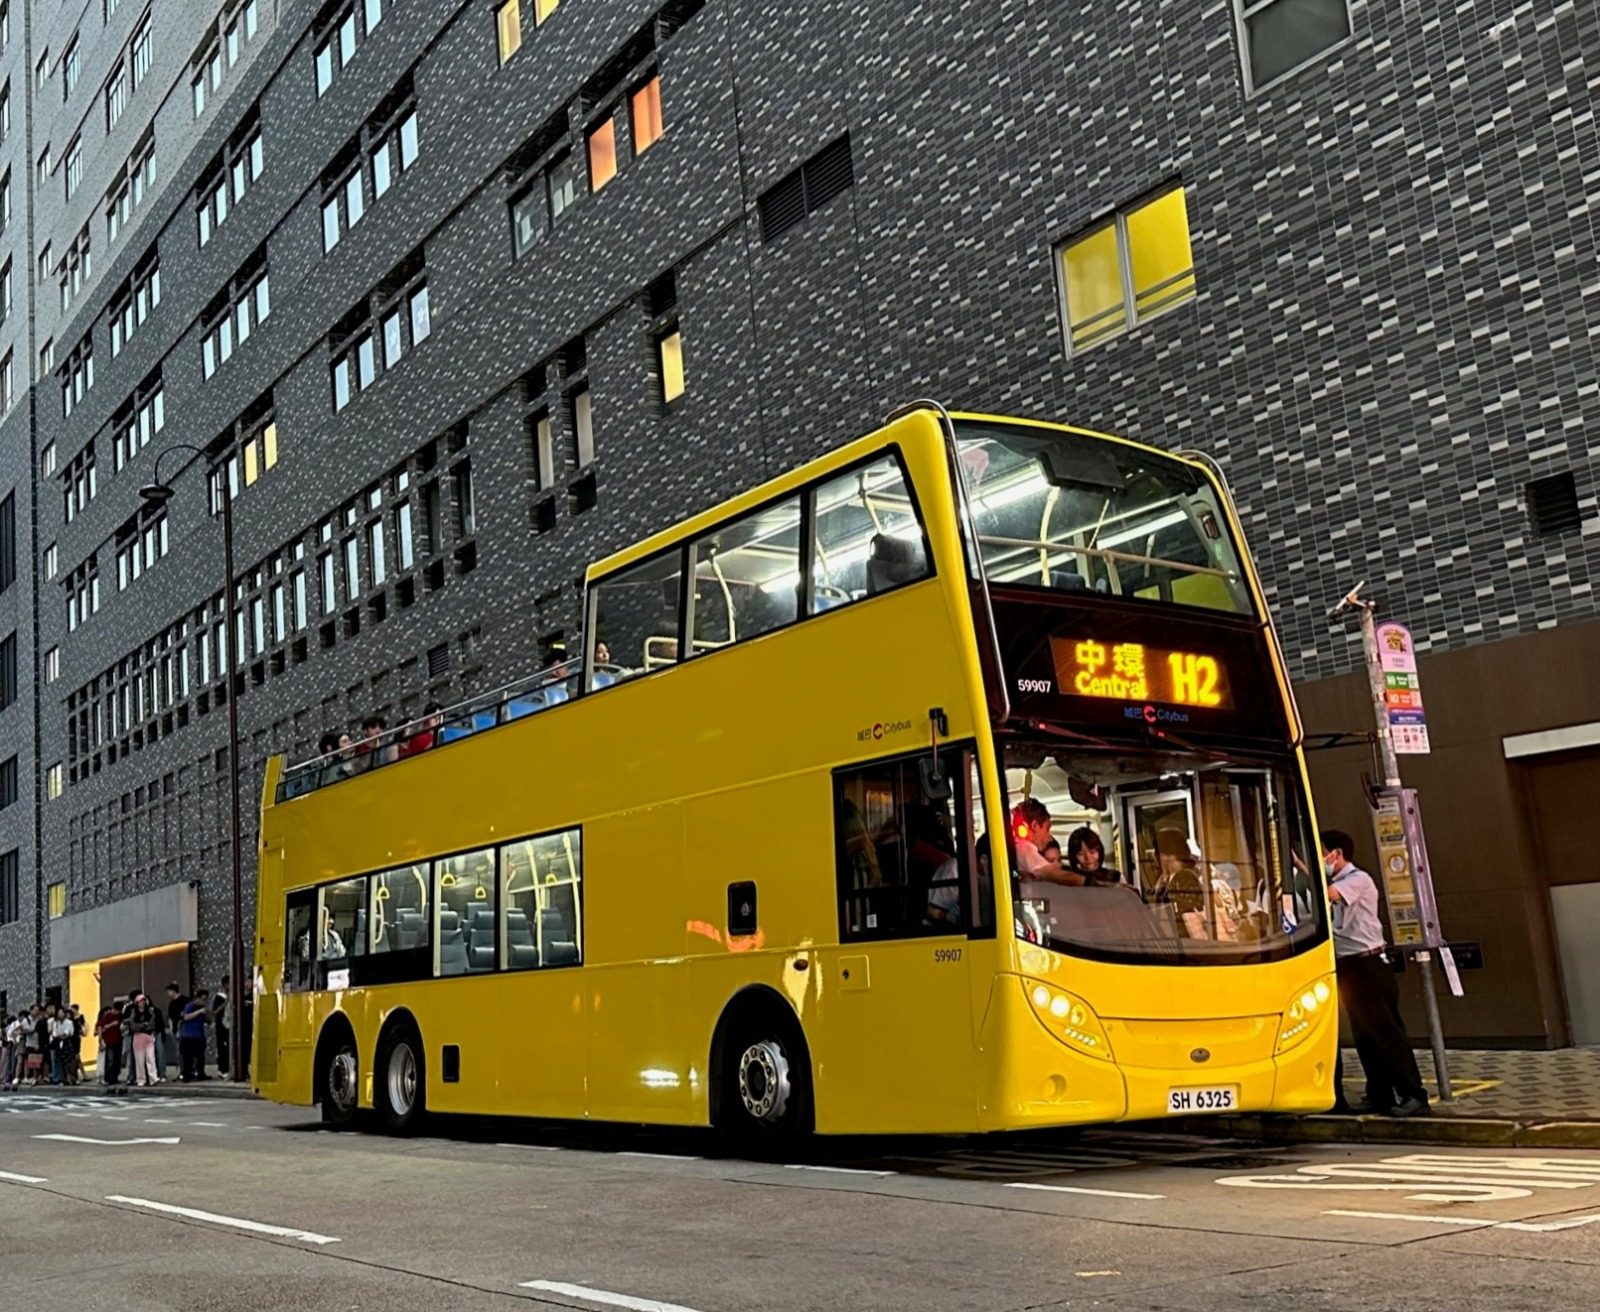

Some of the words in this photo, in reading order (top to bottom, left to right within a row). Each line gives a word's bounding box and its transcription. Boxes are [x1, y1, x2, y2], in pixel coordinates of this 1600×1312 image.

[1075, 639, 1146, 677] 中環
[1017, 678, 1051, 693] 59907
[1075, 672, 1148, 699] Central
[1167, 651, 1222, 706] H2
[1157, 708, 1189, 722] Citybus
[884, 720, 911, 734] Citybus
[935, 948, 962, 962] 59907
[1172, 1091, 1191, 1109] SH
[1196, 1090, 1231, 1108] 6325
